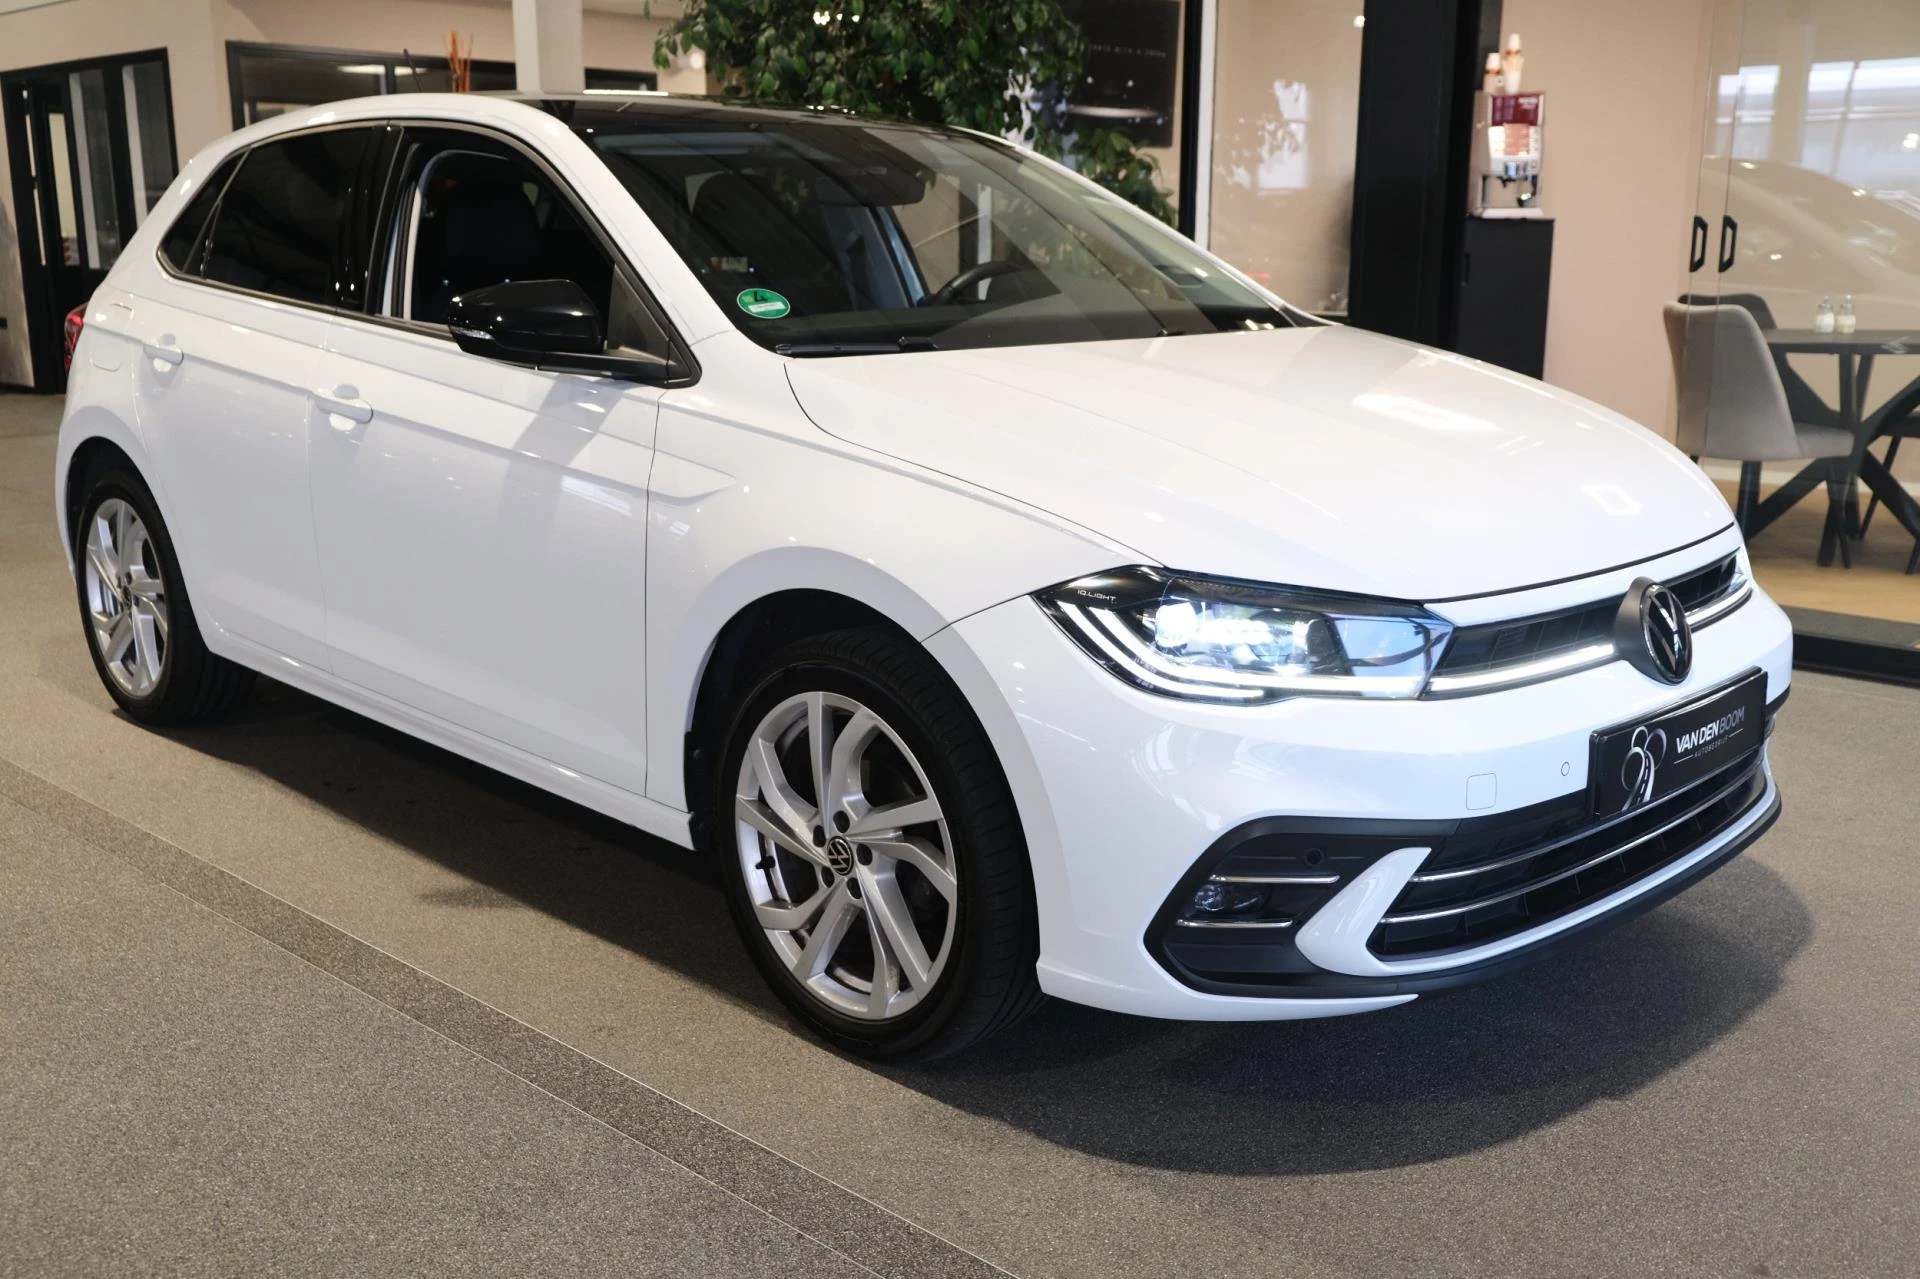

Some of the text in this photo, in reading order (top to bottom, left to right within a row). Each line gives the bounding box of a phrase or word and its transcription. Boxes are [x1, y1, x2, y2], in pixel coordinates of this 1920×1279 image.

[1676, 705, 1745, 754] VAN DEN BOOM
